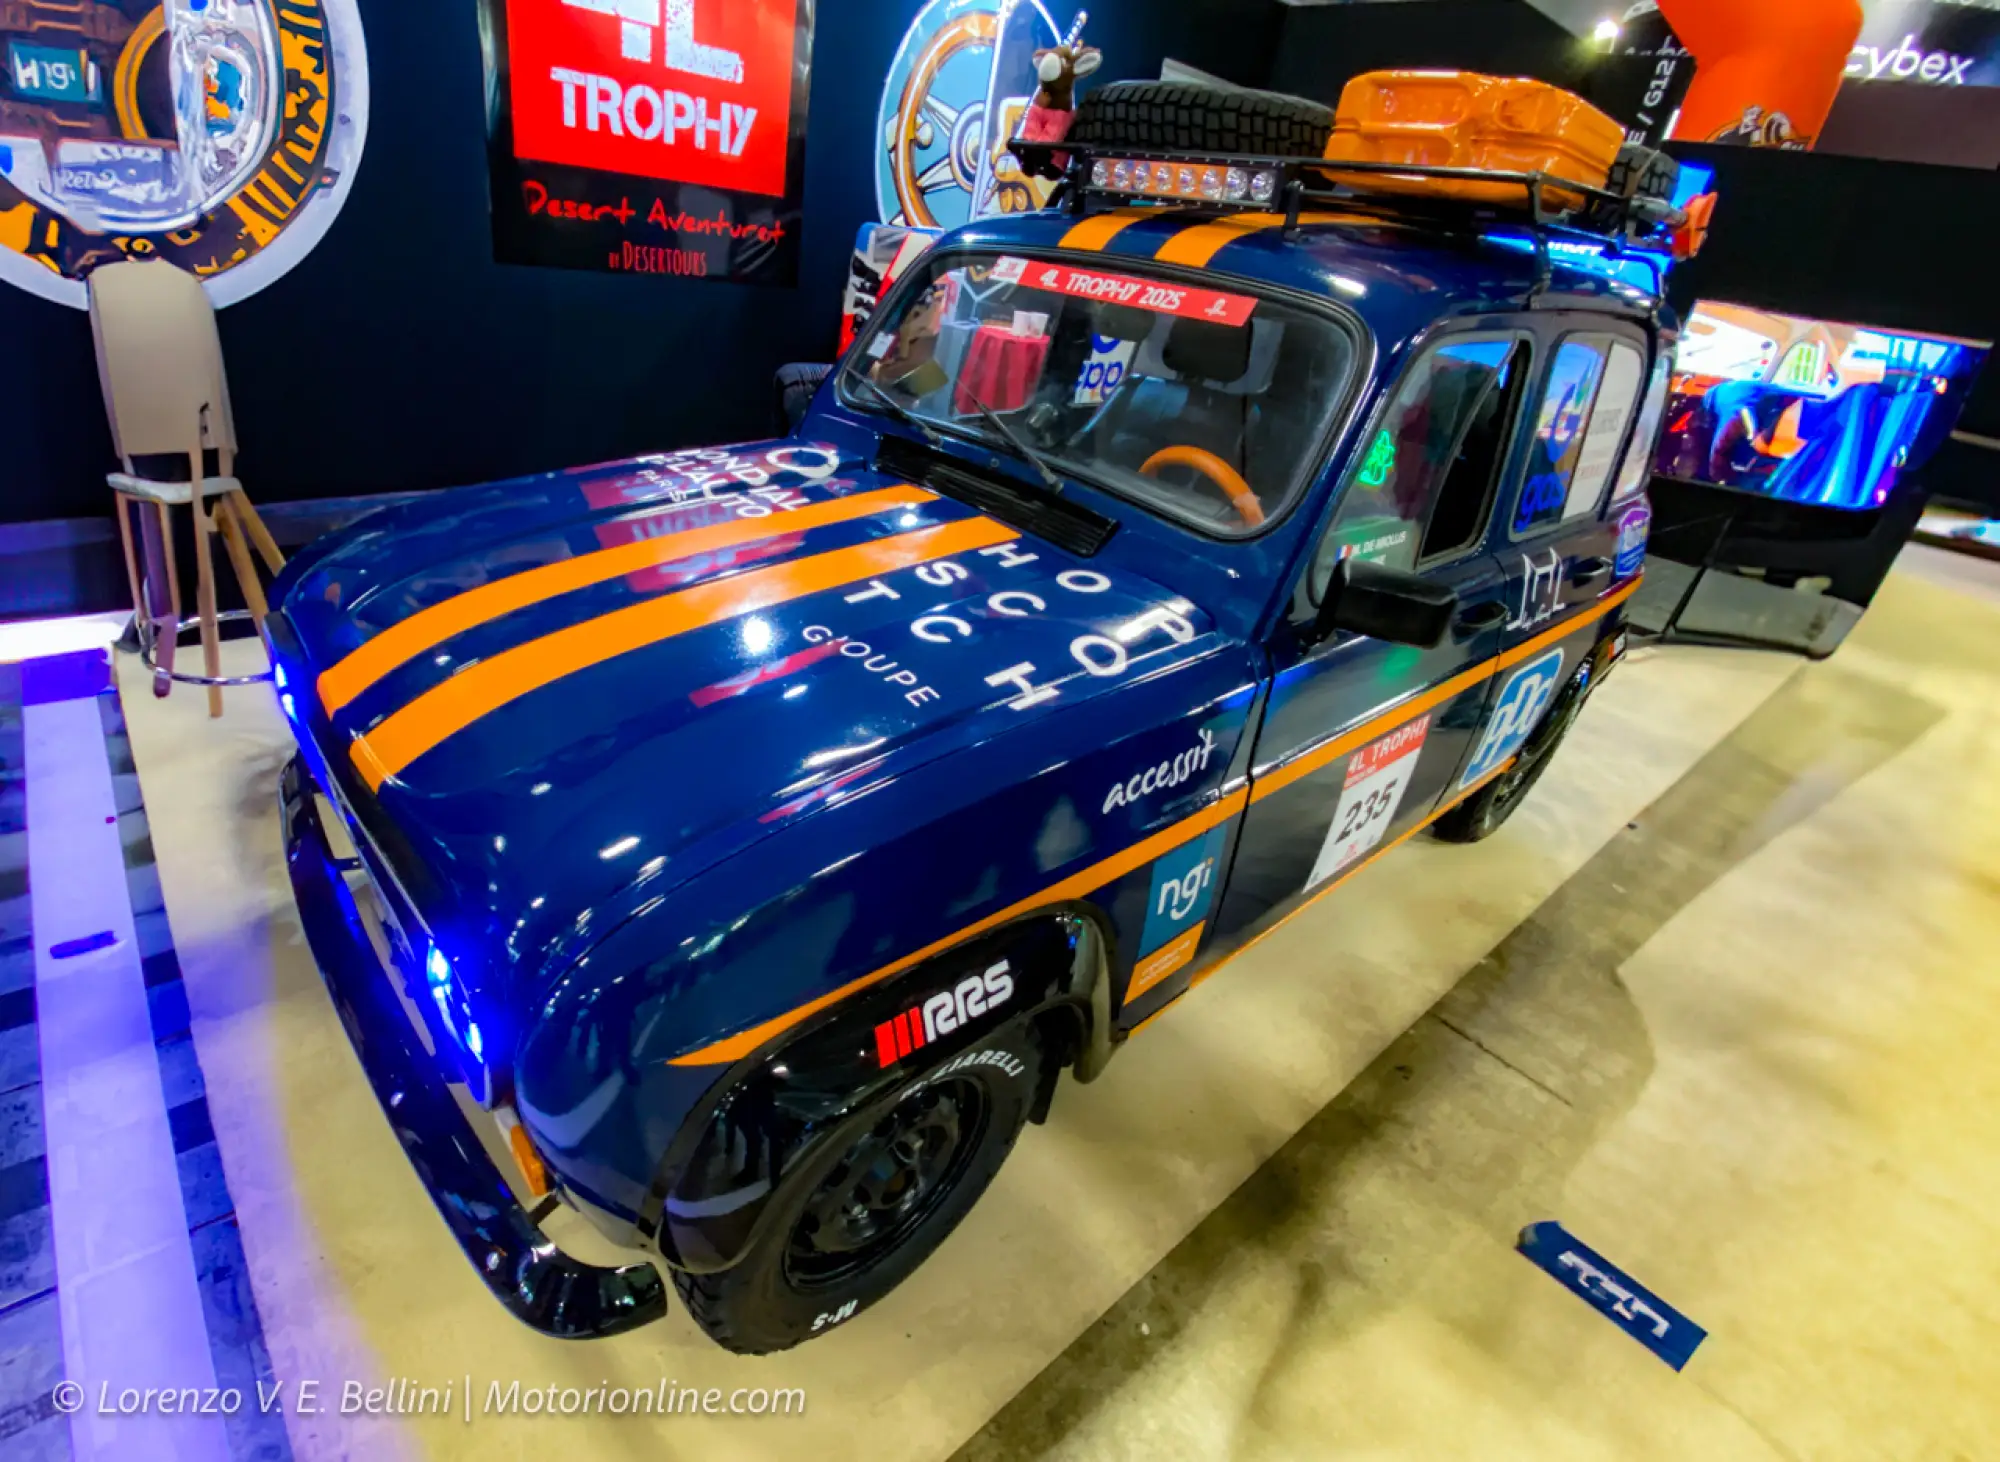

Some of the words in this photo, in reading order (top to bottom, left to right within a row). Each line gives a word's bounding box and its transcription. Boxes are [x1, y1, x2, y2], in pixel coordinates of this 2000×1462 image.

[1843, 33, 1975, 85] cybex
[550, 66, 758, 157] TROPHY
[522, 179, 637, 225] Desert
[1040, 269, 1060, 288] 4L
[1065, 272, 1142, 301] TROPHY
[1138, 286, 1188, 311] 2025
[1334, 777, 1398, 846] 235
[1156, 857, 1215, 921] ngi
[922, 958, 1015, 1043] RRS
